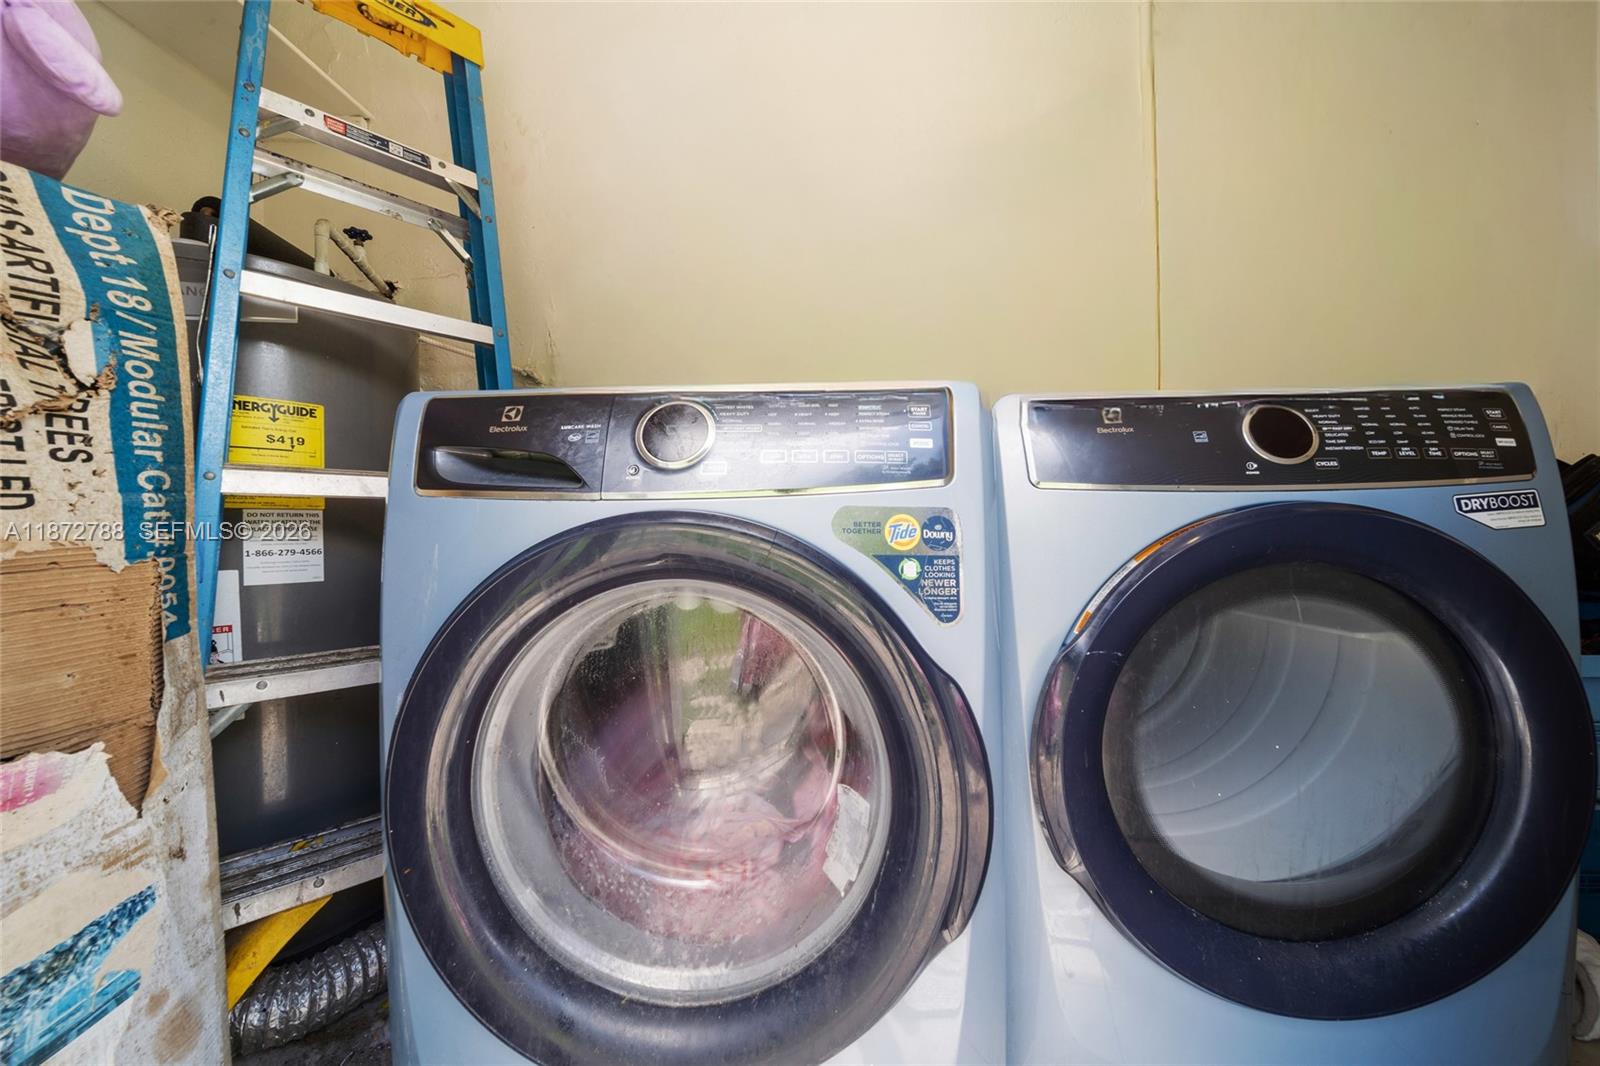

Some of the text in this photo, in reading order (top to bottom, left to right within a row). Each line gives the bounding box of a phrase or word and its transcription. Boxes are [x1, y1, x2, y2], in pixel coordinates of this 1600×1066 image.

[386, 0, 416, 17] ER
[61, 186, 137, 269] Dept.
[118, 330, 169, 463] Modular
[489, 425, 528, 433] Electrolux
[1460, 493, 1535, 511] DRYBOOST
[888, 524, 918, 544] Tide
[923, 529, 953, 541] Downy
[245, 547, 323, 558] 1-866-279-4566
[921, 579, 957, 587] NEWER
